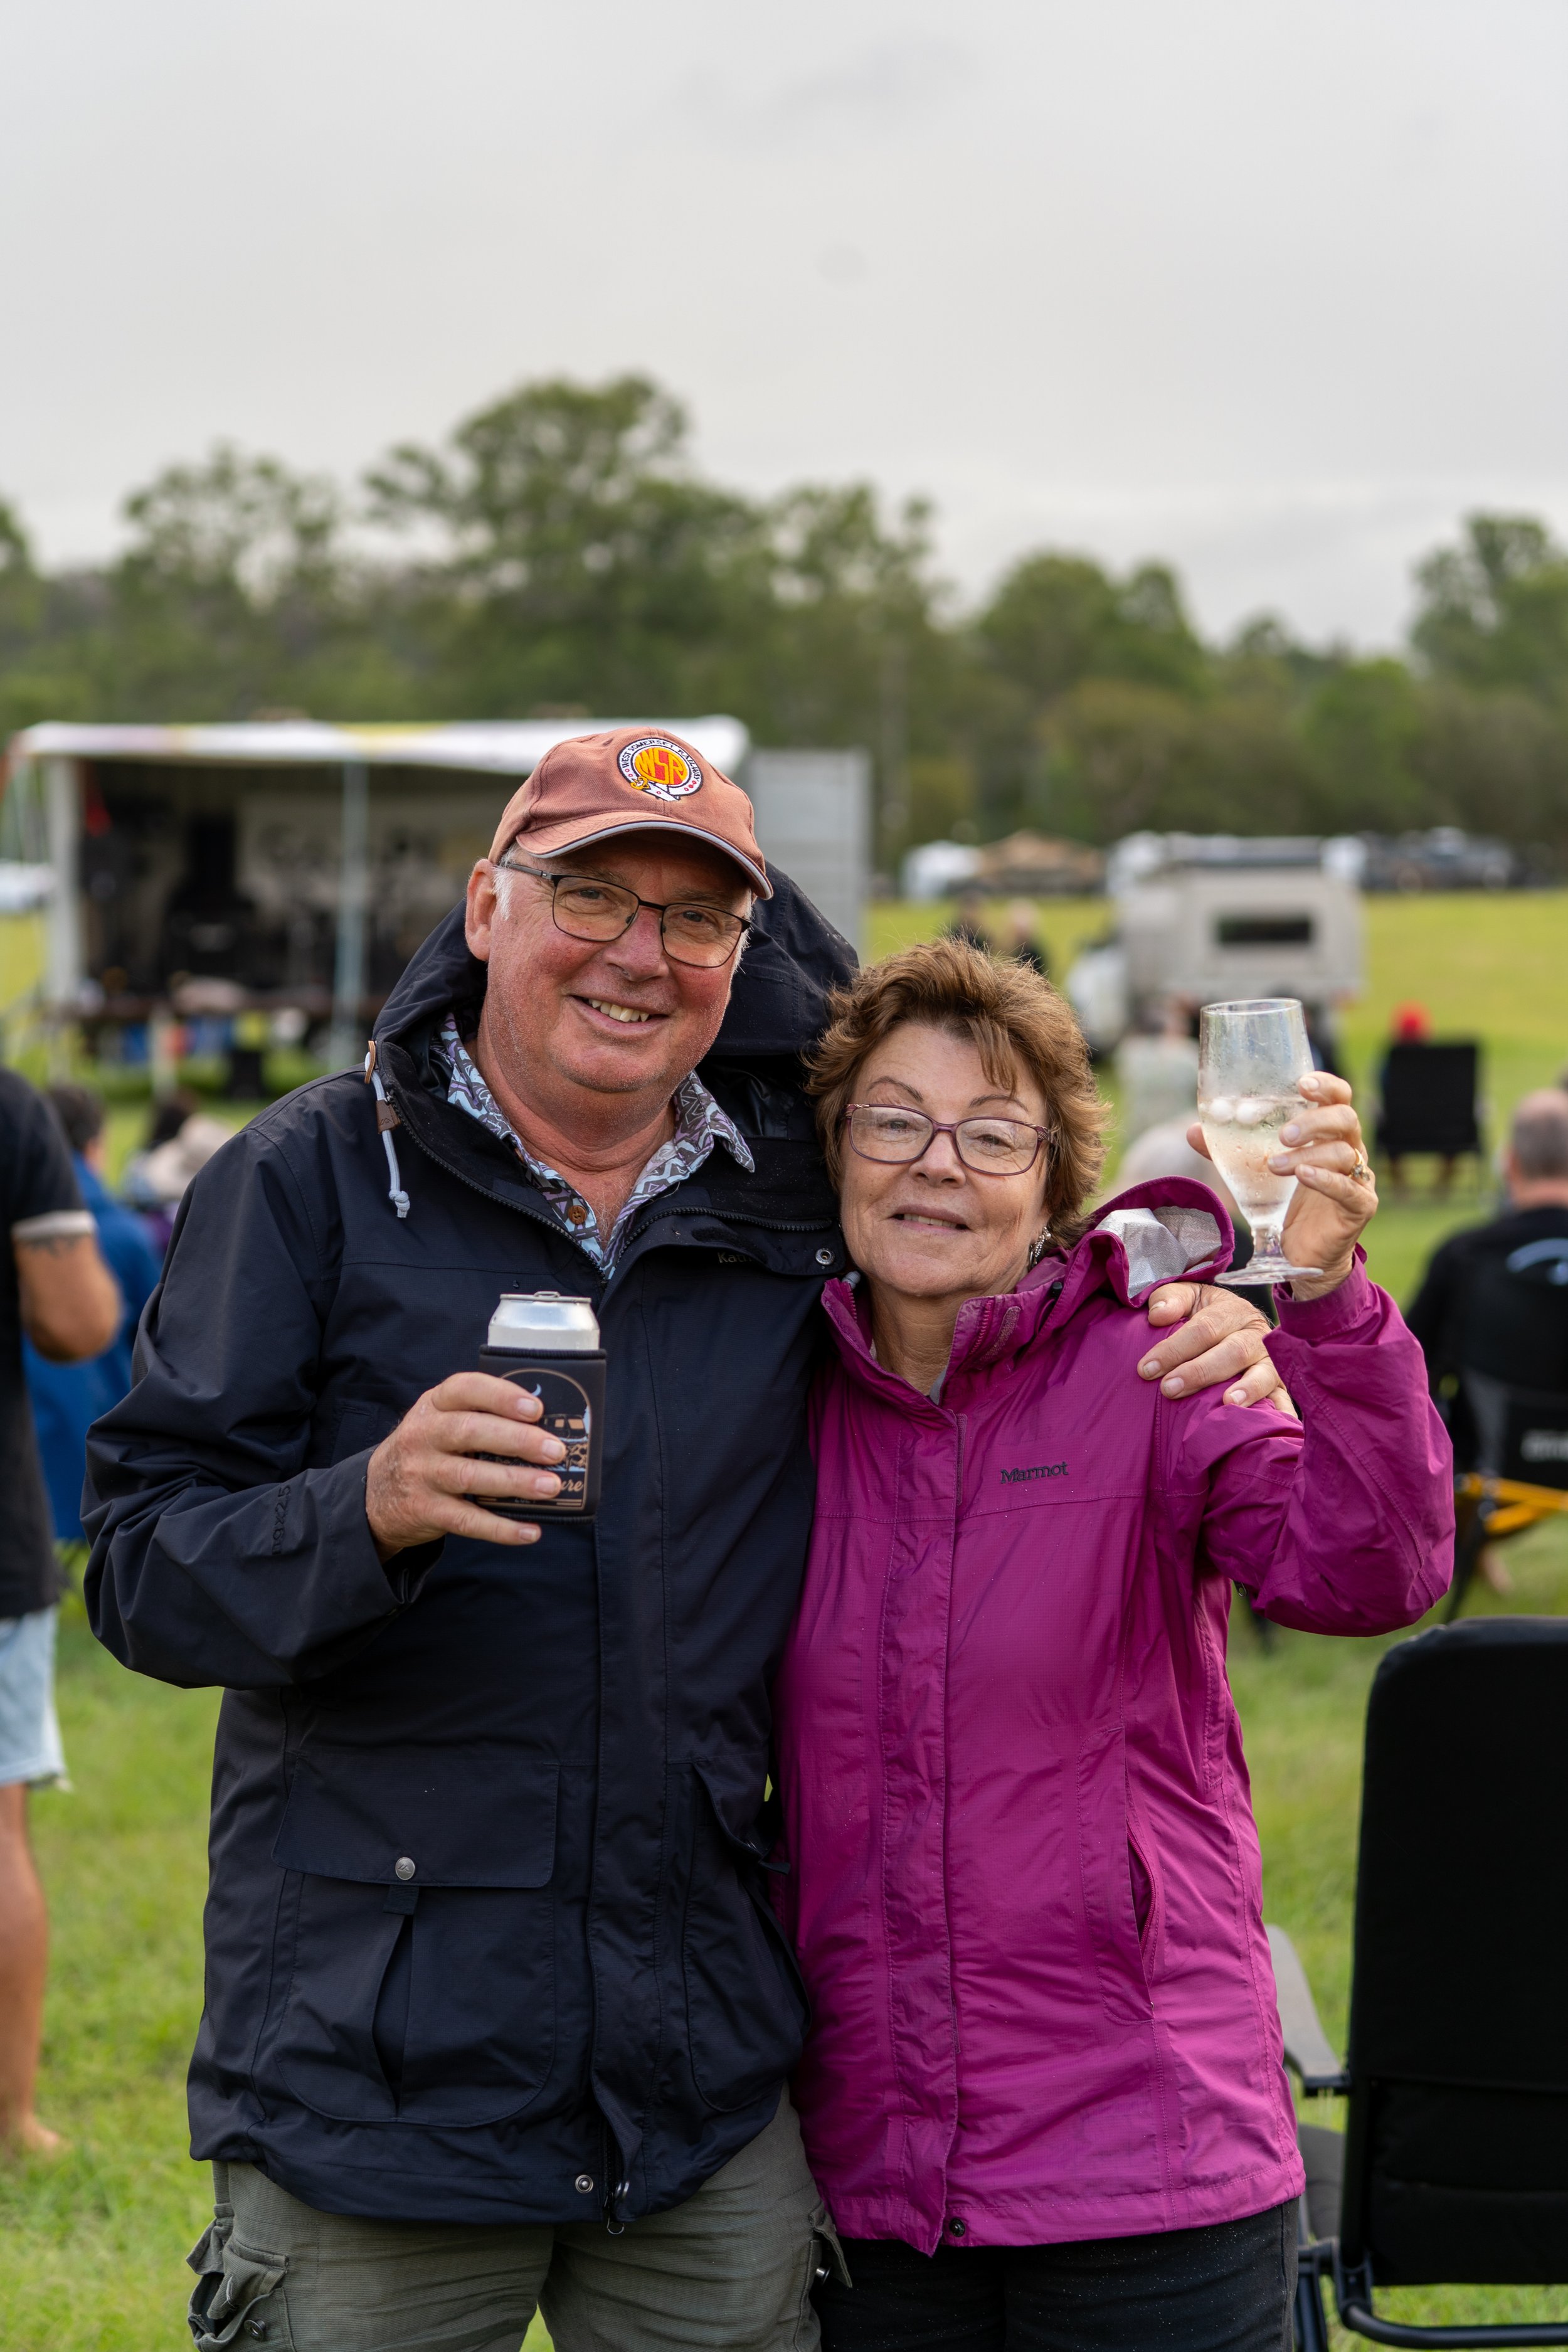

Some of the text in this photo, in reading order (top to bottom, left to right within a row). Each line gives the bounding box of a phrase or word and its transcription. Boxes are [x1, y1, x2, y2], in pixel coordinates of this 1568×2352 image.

[622, 739, 701, 781] WEST SOMERSET RAILWAY
[635, 747, 688, 785] WSR
[1000, 1461, 1069, 1484] Marmot
